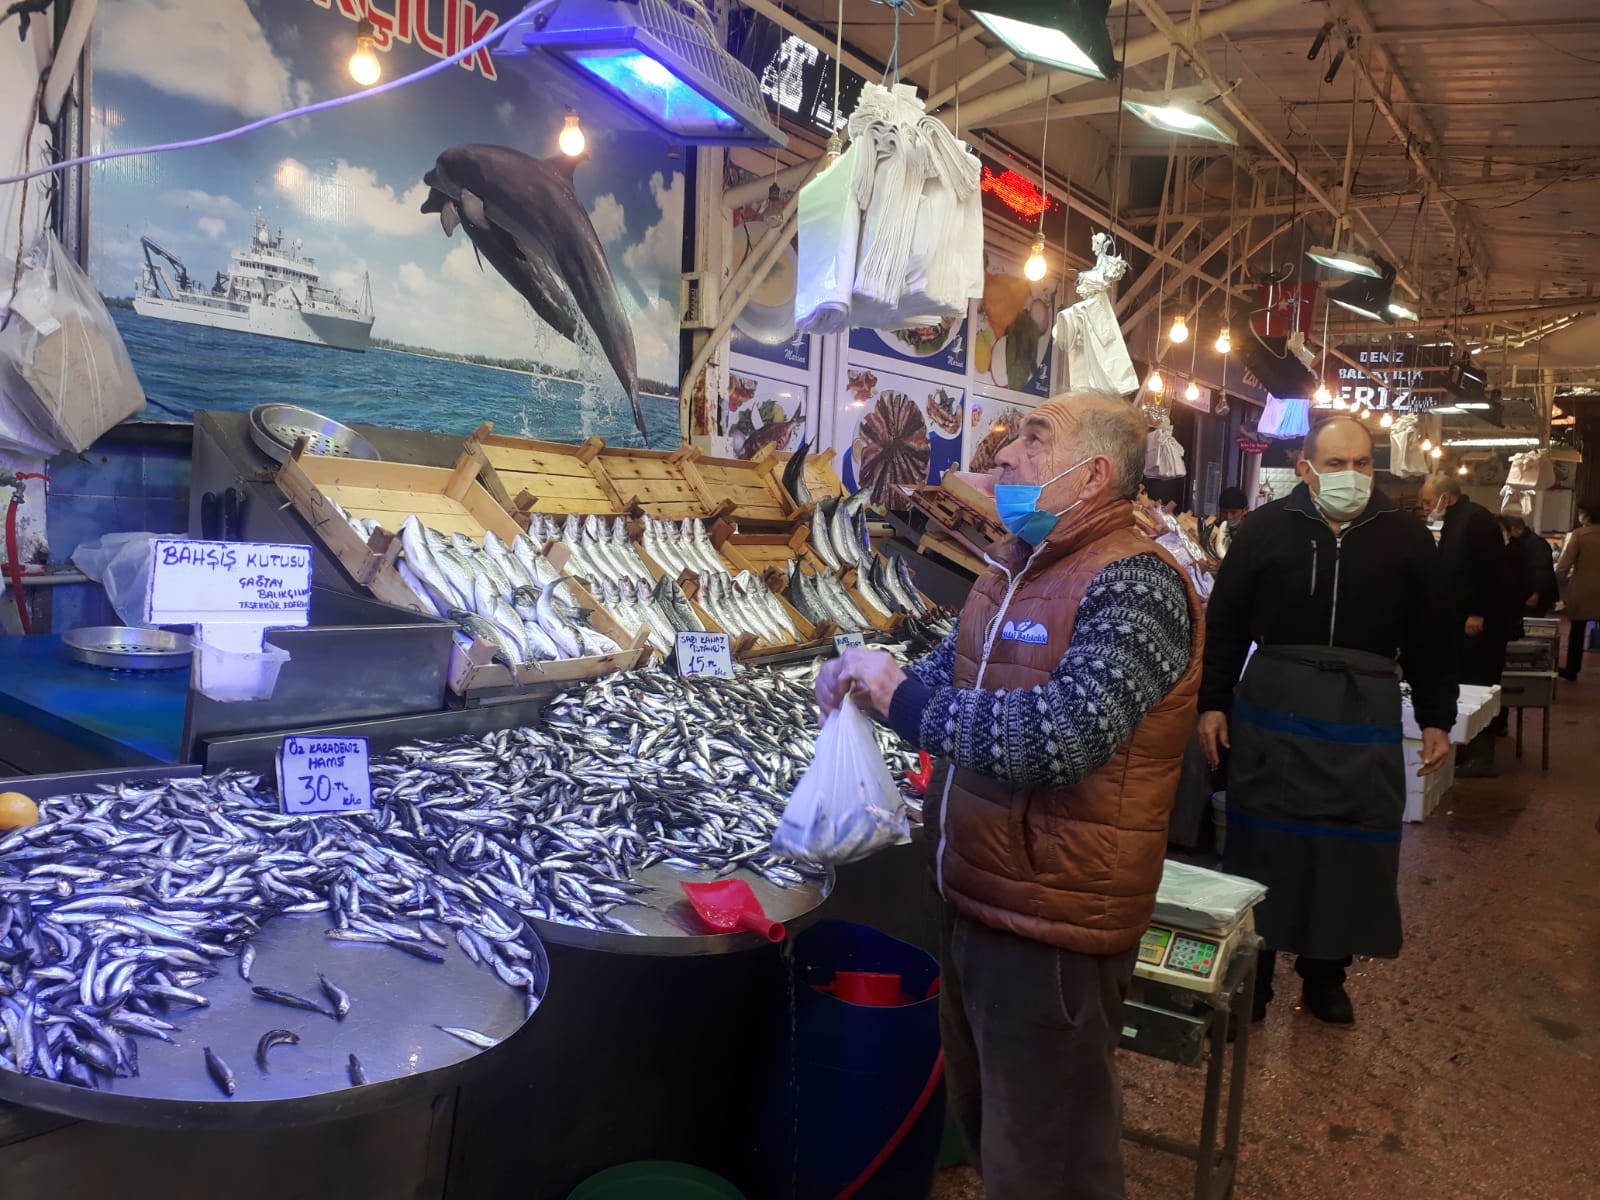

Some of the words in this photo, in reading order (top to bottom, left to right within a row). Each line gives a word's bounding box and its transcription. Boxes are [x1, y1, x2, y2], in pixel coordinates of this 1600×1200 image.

[313, 0, 498, 81] ÇILIK
[163, 544, 237, 571] BAHŞİŞ
[247, 553, 305, 568] KUTUSU
